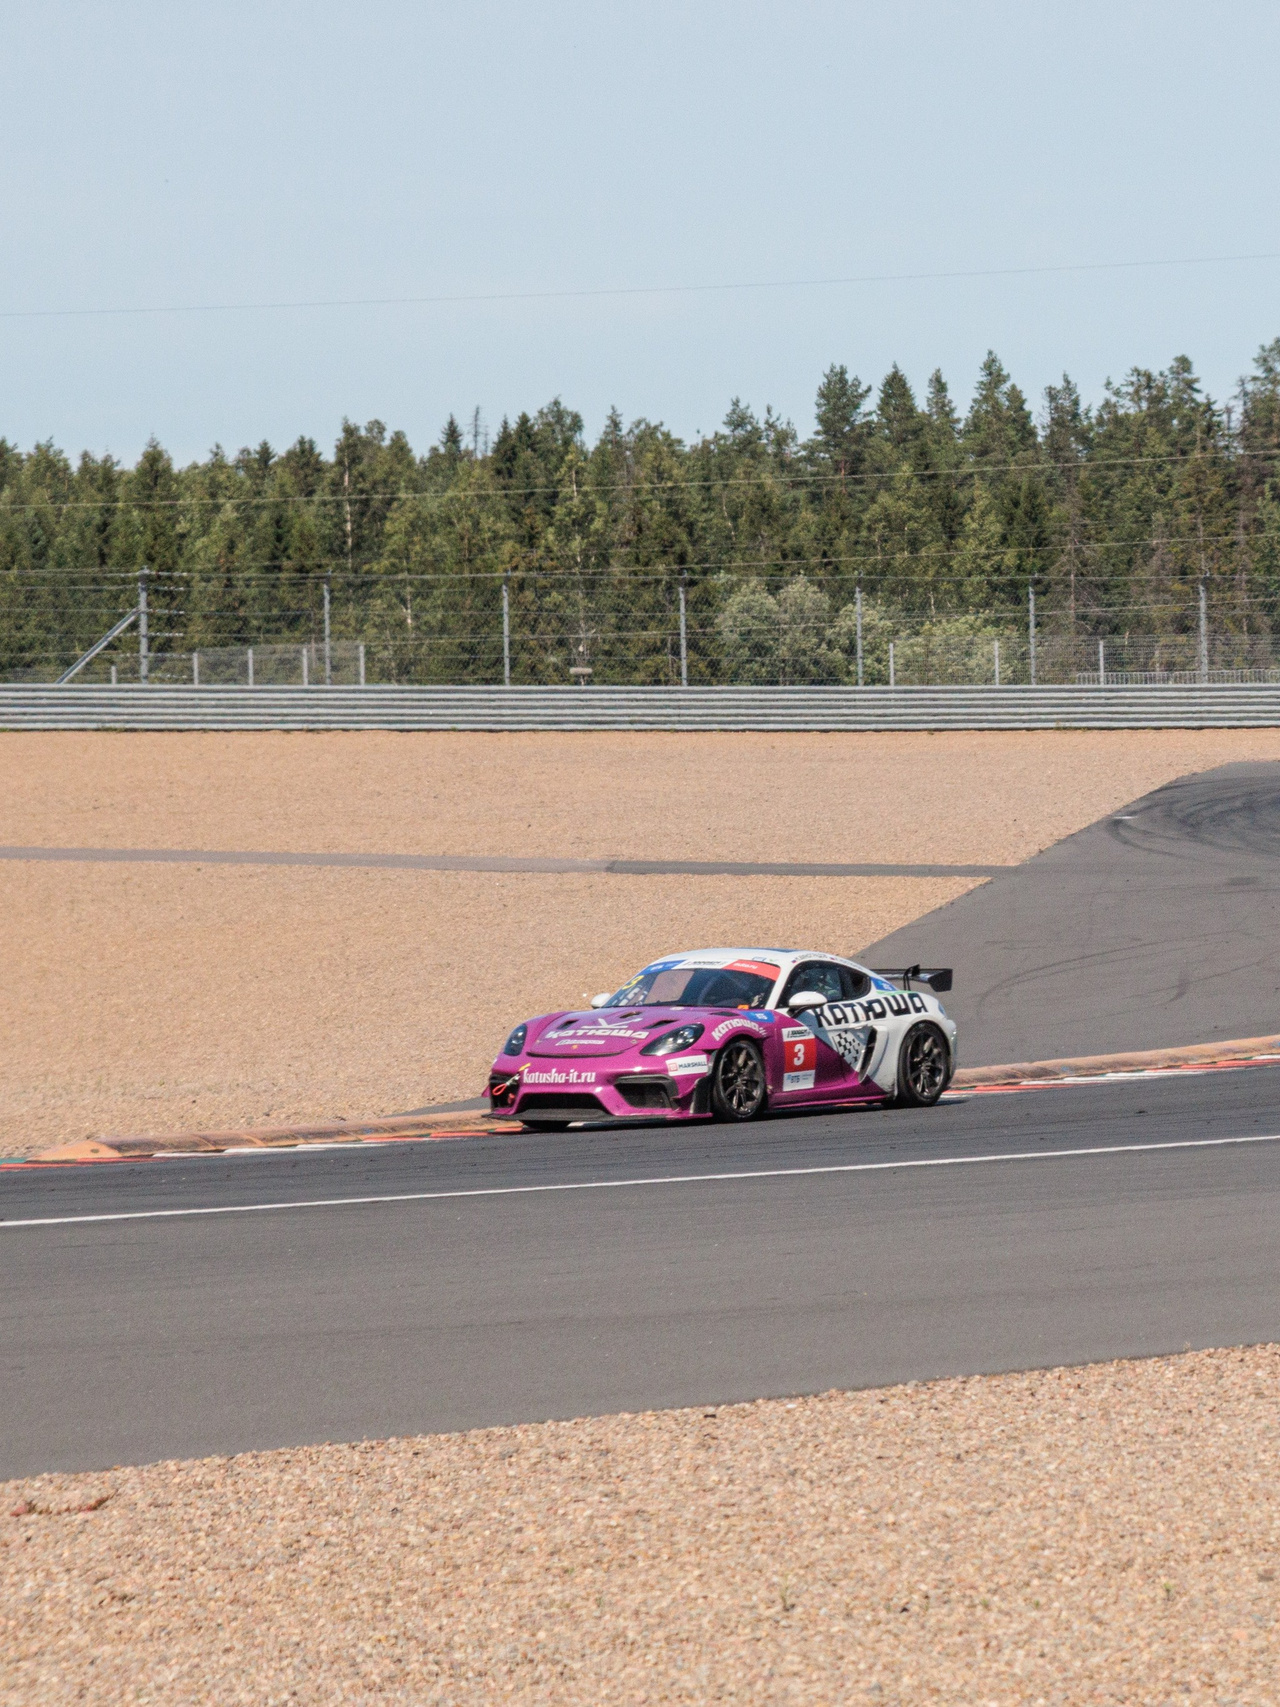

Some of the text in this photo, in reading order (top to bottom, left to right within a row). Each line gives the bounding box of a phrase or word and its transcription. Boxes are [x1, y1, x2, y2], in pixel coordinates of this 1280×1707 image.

[622, 975, 645, 991] 3
[812, 992, 929, 1029] КАТЮША
[545, 1029, 650, 1040] КАТЮША
[793, 1043, 806, 1066] 3
[678, 1061, 708, 1069] MARSHALL
[523, 1068, 595, 1085] katusha-it.ru
